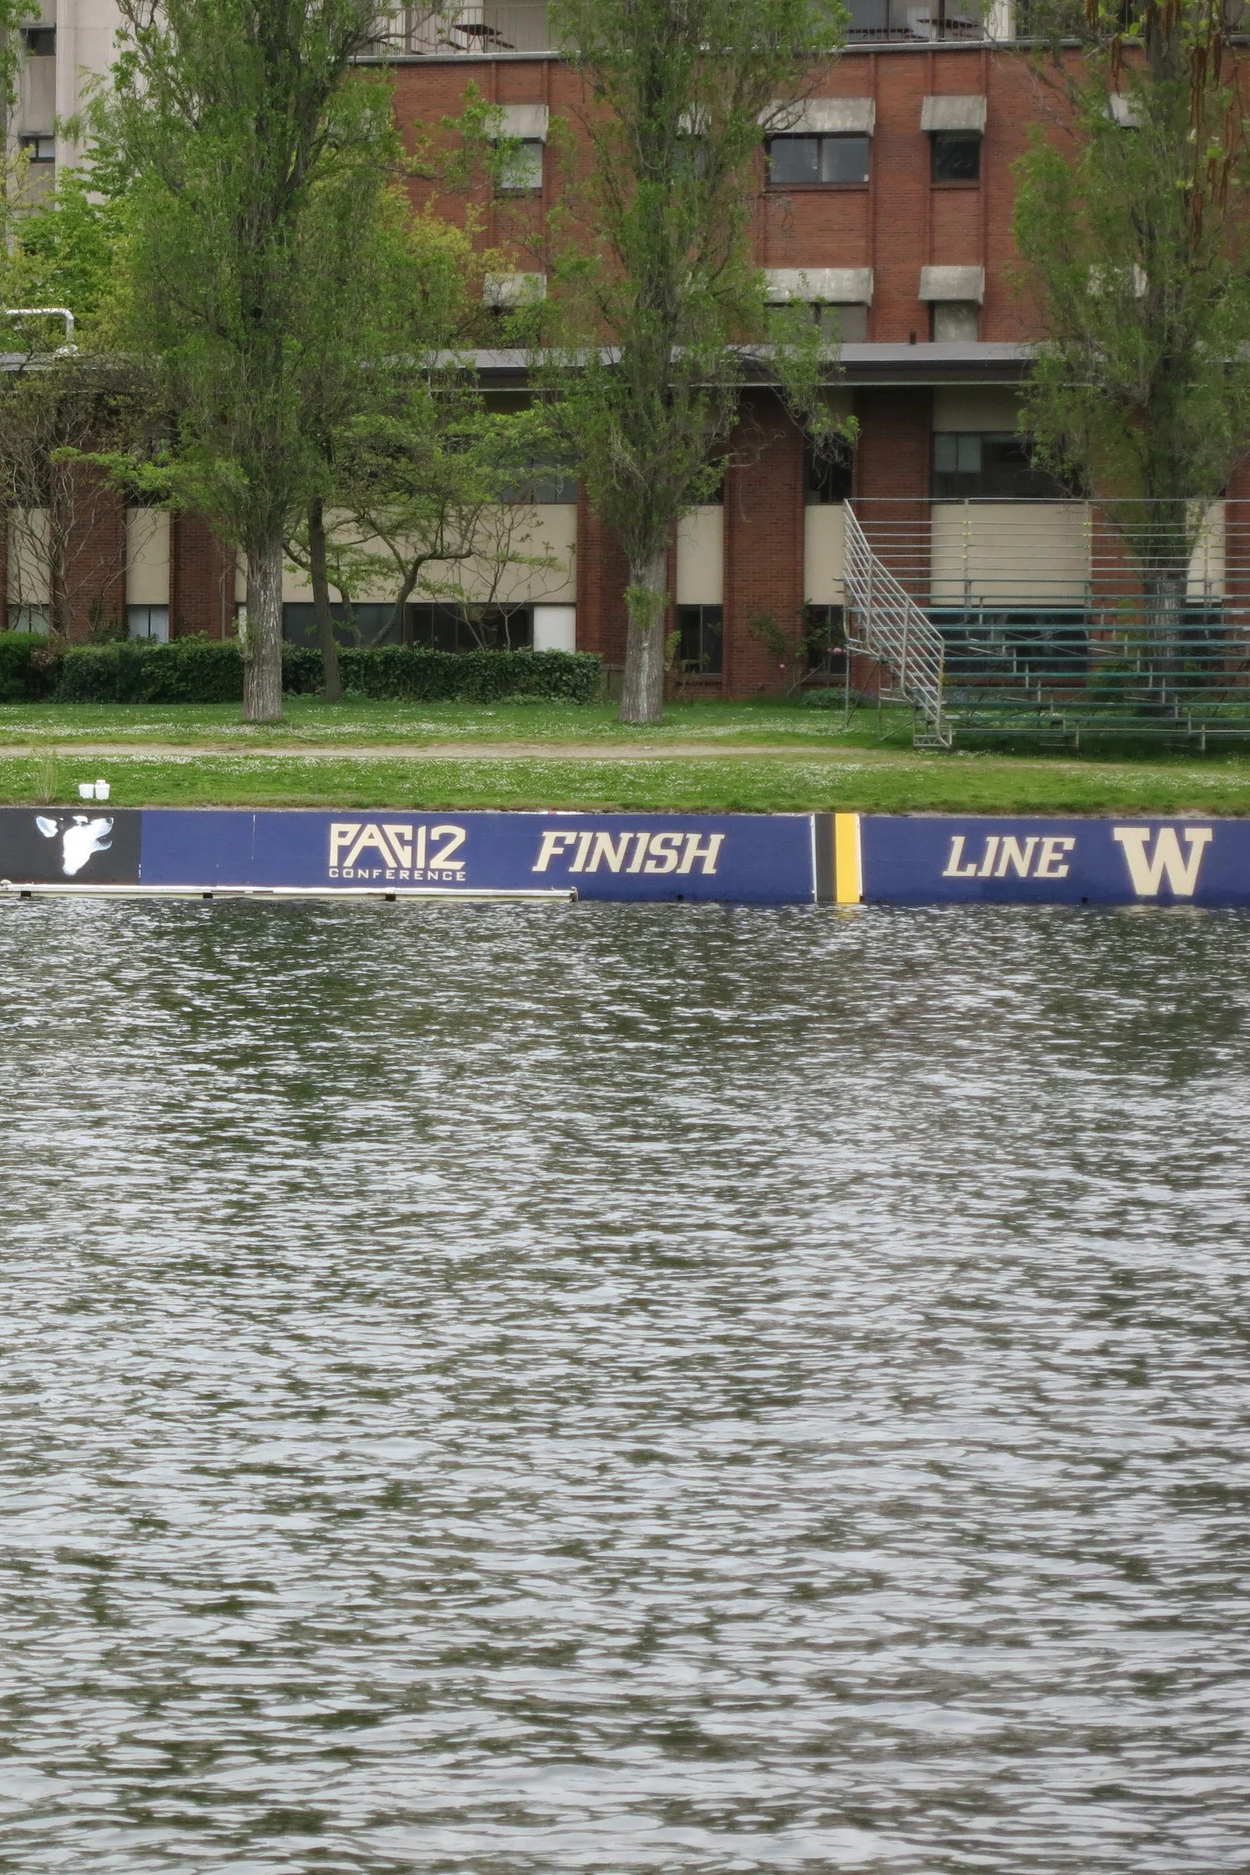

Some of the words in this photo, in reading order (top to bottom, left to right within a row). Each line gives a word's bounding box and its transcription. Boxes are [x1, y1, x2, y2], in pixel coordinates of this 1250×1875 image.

[328, 867, 466, 882] CONFERENCE
[531, 831, 726, 875] FINISH
[942, 835, 1076, 878] LINE
[1113, 827, 1213, 896] W
